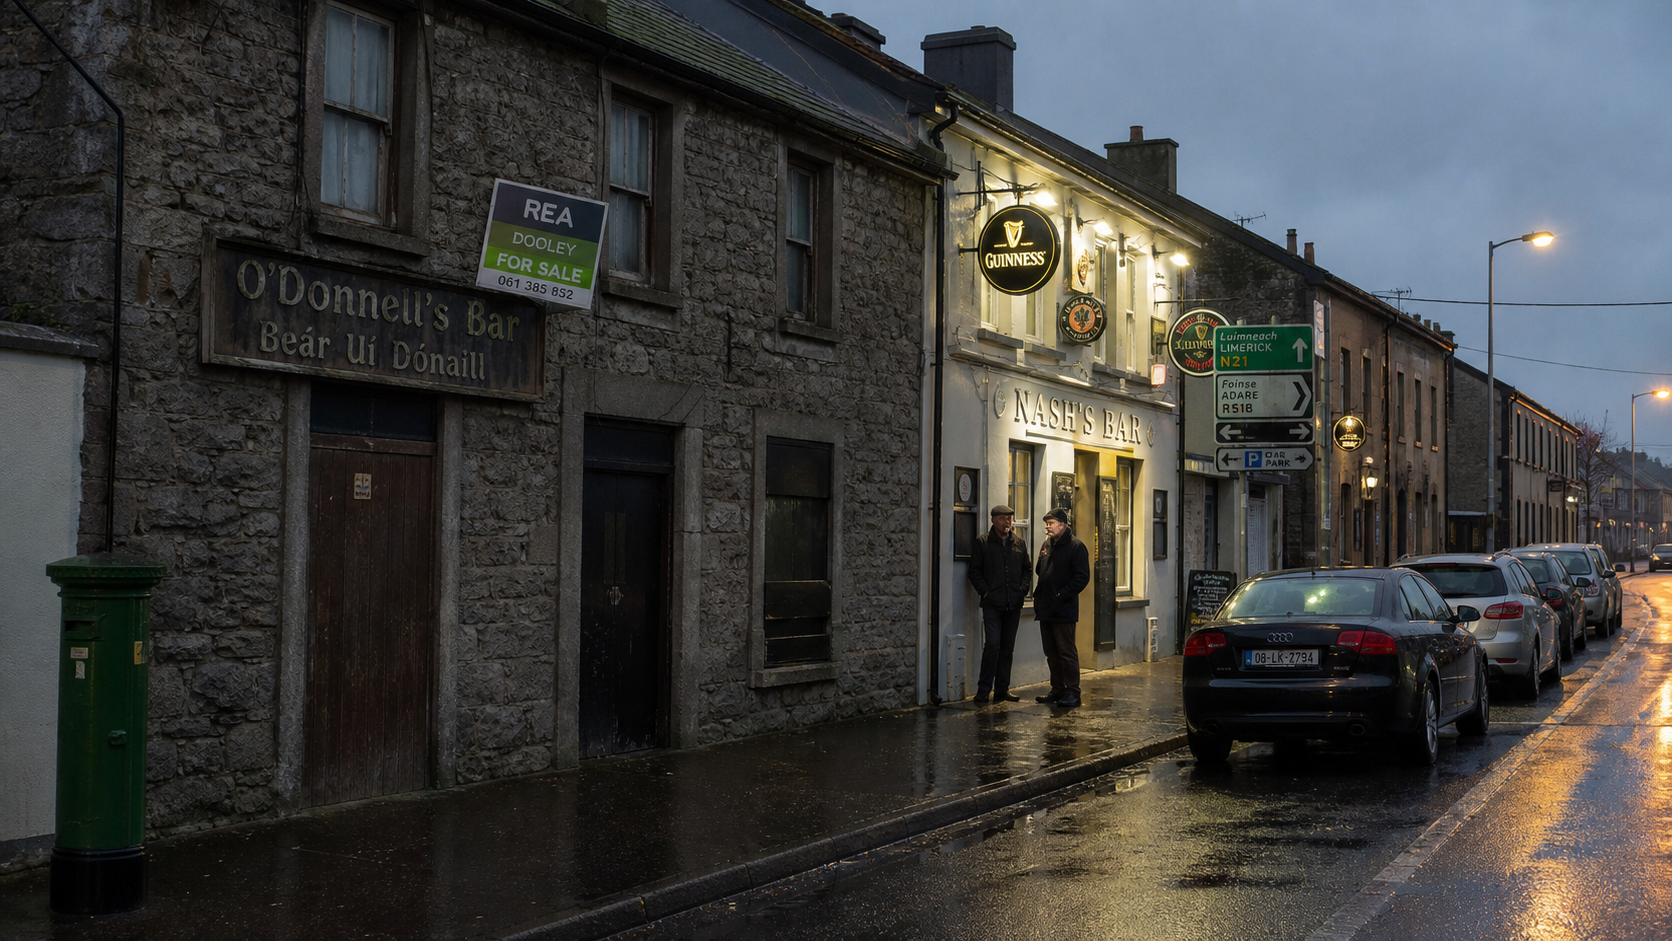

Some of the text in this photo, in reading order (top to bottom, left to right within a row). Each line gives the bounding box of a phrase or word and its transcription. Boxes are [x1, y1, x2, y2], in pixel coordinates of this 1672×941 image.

[523, 198, 574, 229] REA
[512, 231, 577, 257] DOOLEY
[496, 252, 584, 284] FOR SALE
[985, 251, 1046, 270] GUINNESS
[497, 275, 574, 300] 061 385 852
[236, 259, 521, 342] O'Donnell's Bar
[1219, 331, 1278, 342] Luimneach
[258, 320, 486, 381] Beár Uí Dónaill
[1220, 343, 1273, 353] LIMERICK
[1220, 356, 1248, 367] N21
[1221, 379, 1257, 389] Foinse
[1221, 390, 1259, 400] ADARE
[1014, 387, 1142, 445] NASH'S BAR
[1248, 452, 1260, 466] P
[1264, 459, 1291, 467] PARK
[1254, 651, 1314, 665] 08-LK-2794
